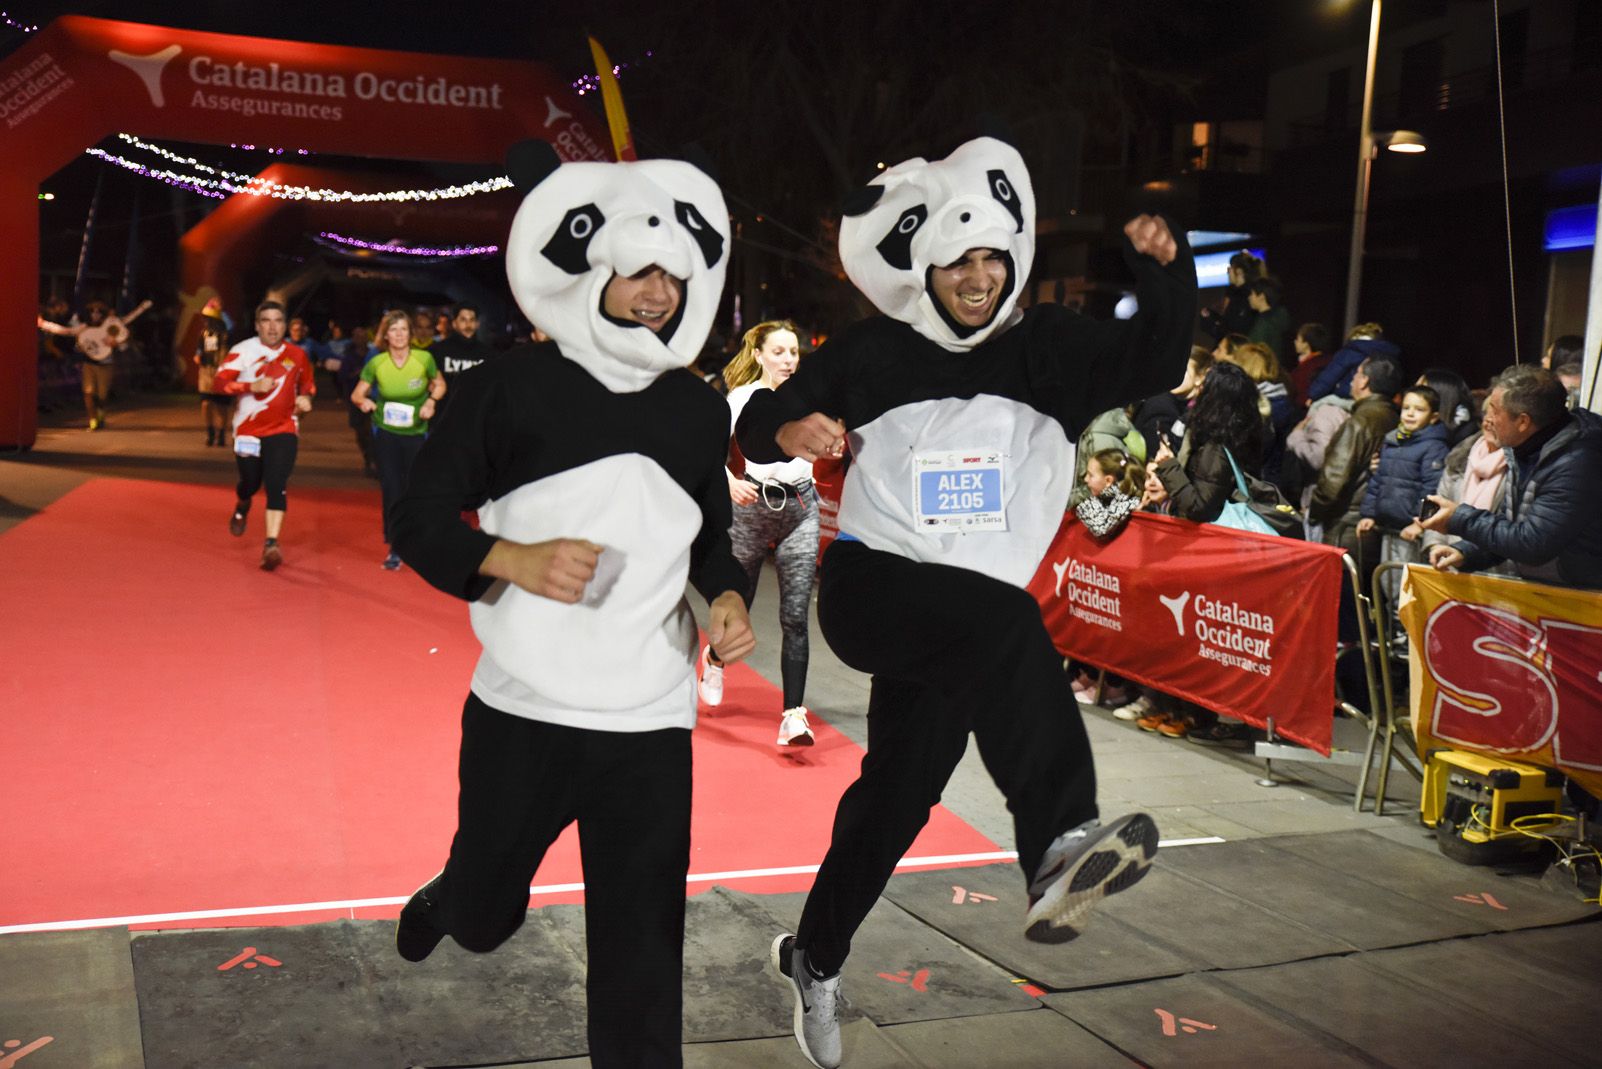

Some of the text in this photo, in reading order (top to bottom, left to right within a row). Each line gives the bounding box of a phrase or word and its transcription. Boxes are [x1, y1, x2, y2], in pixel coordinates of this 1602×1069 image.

[188, 56, 504, 110] Catalana Occident
[190, 90, 343, 121] Assegurances
[938, 473, 983, 491] ALEX
[938, 492, 984, 510] 2105
[1068, 559, 1120, 594] Catalana
[1067, 581, 1121, 617] Occident
[1194, 594, 1274, 634] Catalana
[1069, 603, 1122, 632] Assegurances
[1195, 619, 1272, 660] Occident
[1198, 643, 1272, 677] Assegurances
